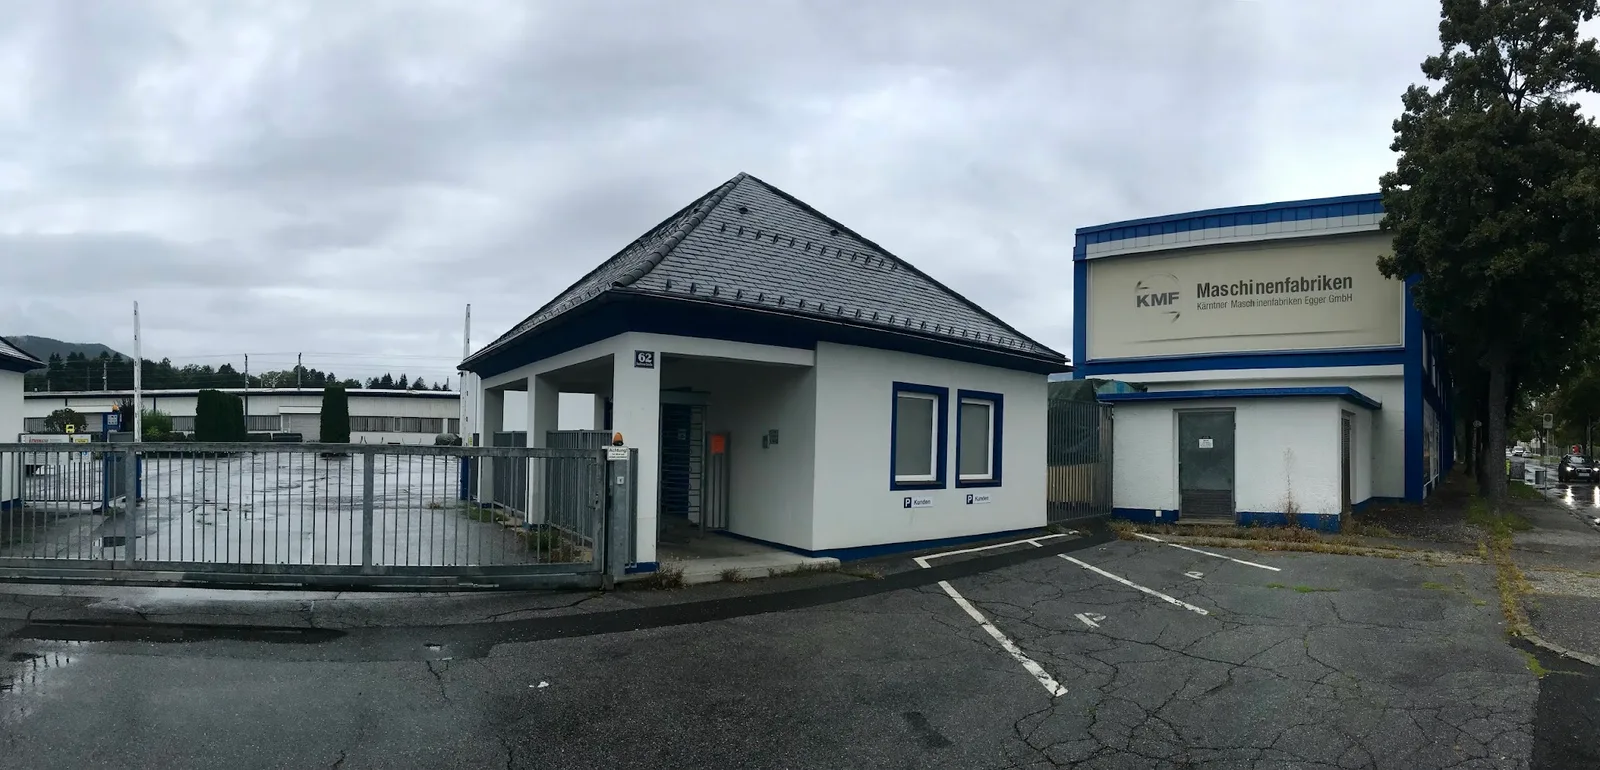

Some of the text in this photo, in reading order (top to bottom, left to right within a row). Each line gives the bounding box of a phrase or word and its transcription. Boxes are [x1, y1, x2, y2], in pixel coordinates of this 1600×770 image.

[1196, 274, 1353, 298] Maschinenfabriken
[1136, 291, 1180, 308] KMF
[1196, 293, 1353, 311] Kärntner Maschinenfabriken Egger GmbH
[638, 352, 652, 363] 62
[905, 498, 911, 507] P
